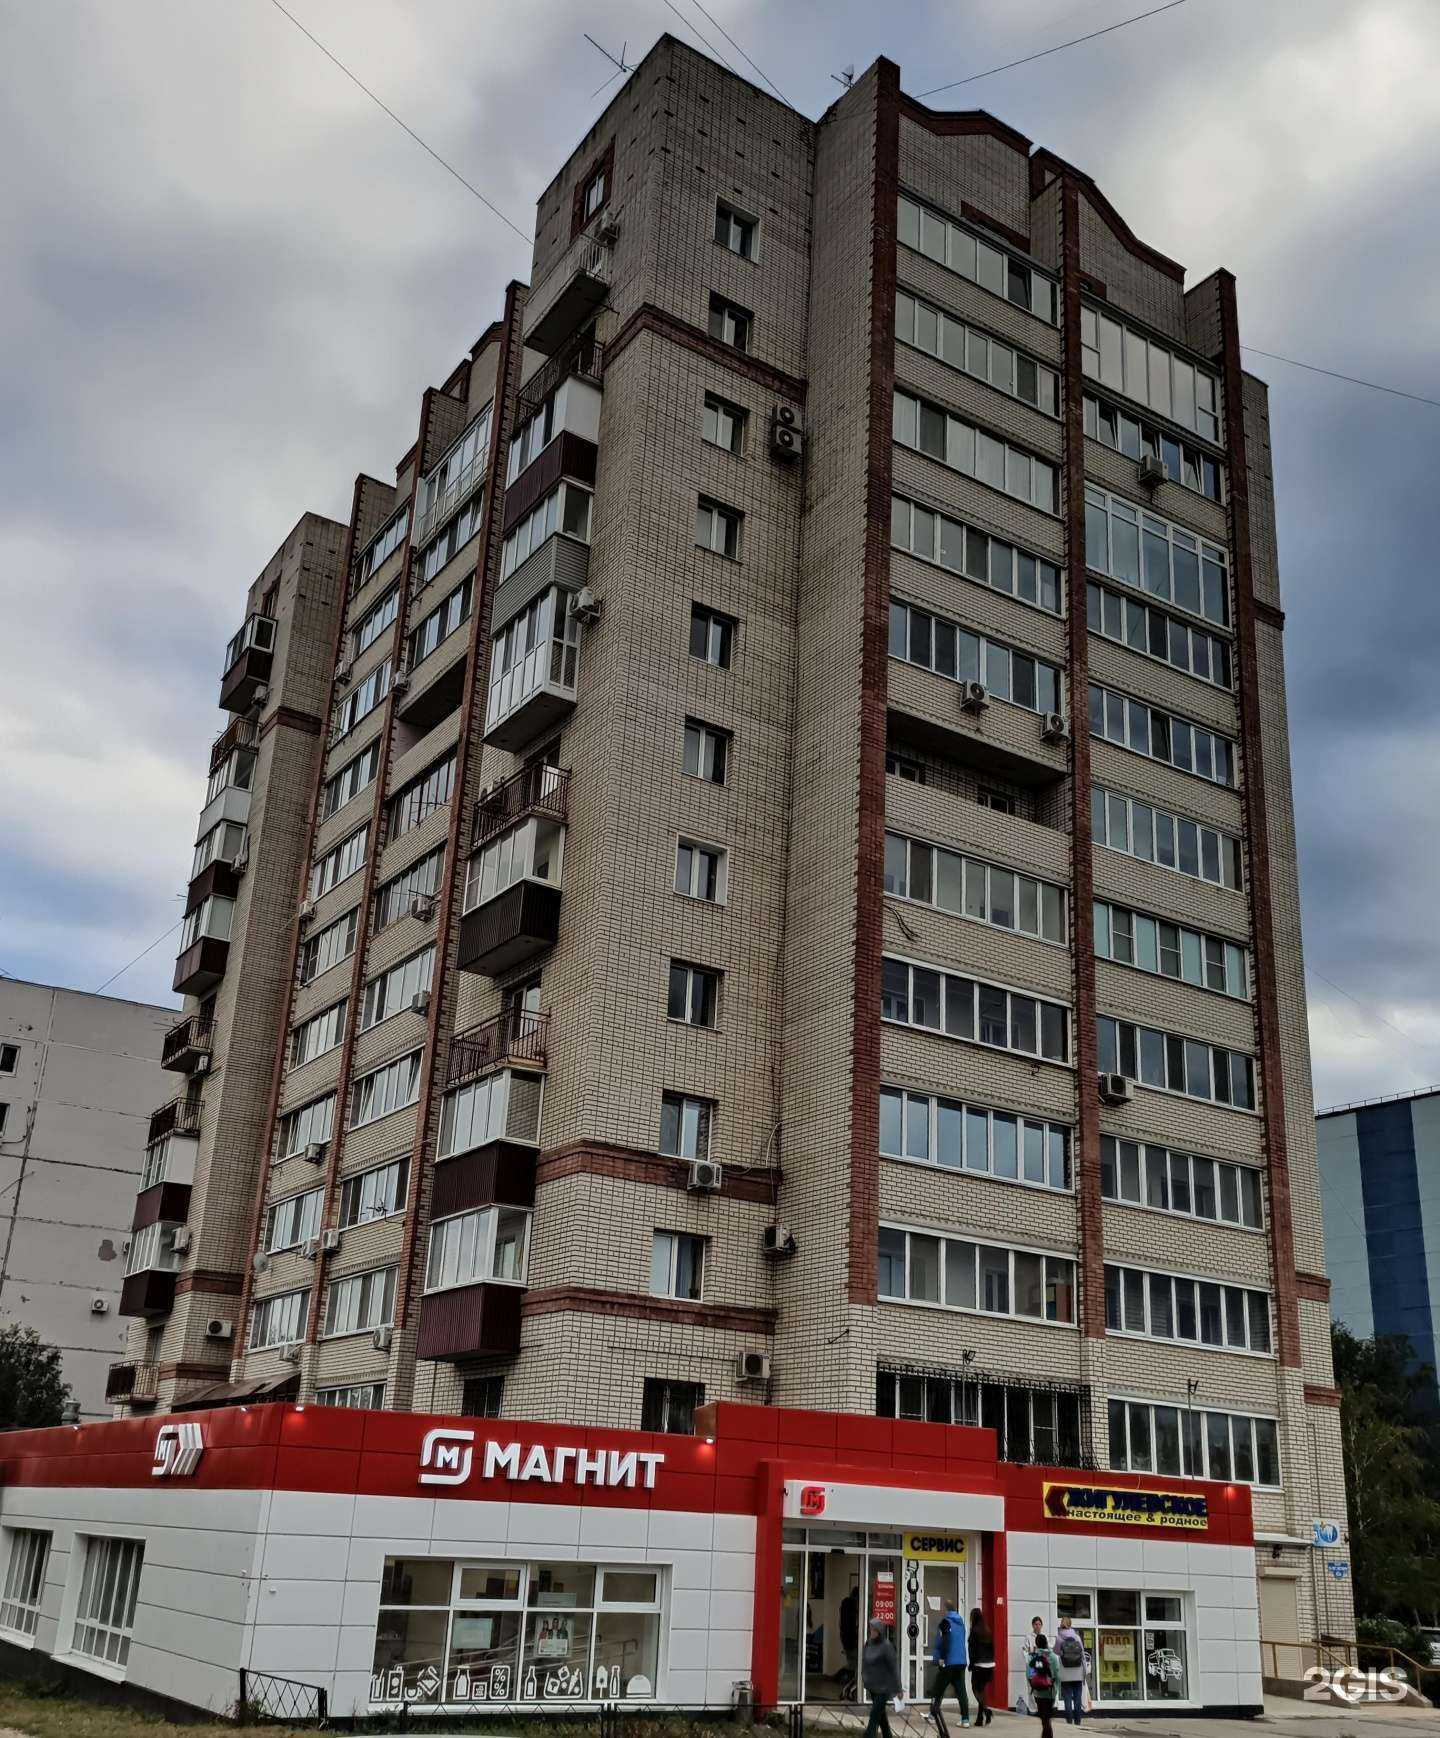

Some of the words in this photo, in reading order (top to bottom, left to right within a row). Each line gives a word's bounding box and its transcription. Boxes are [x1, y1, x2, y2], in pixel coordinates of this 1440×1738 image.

[483, 1440, 666, 1488] МАГНИТ
[1066, 1509, 1142, 1522] настоящее
[1146, 1512, 1155, 1523] &
[1161, 1515, 1208, 1527] родное
[910, 1536, 965, 1553] СЕРВИС
